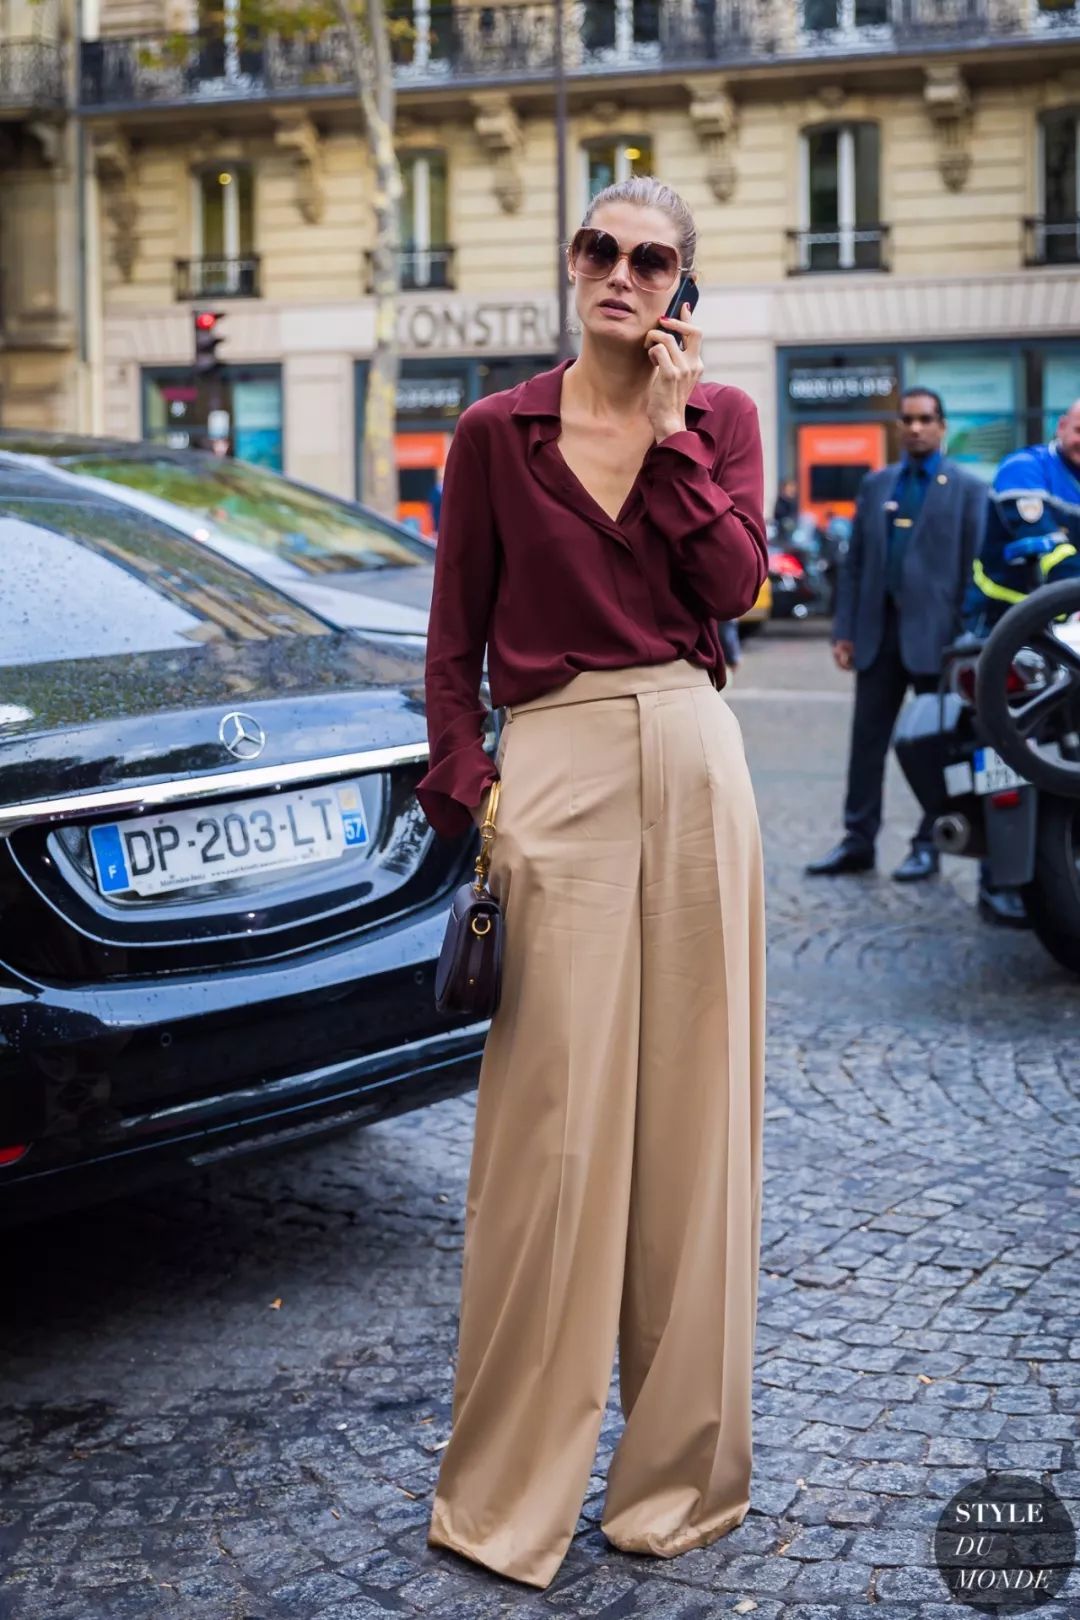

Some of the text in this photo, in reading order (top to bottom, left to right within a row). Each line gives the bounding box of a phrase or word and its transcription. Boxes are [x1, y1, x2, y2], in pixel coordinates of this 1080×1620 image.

[125, 798, 333, 876] DP-203-LT
[345, 818, 363, 840] 57
[108, 865, 117, 880] F
